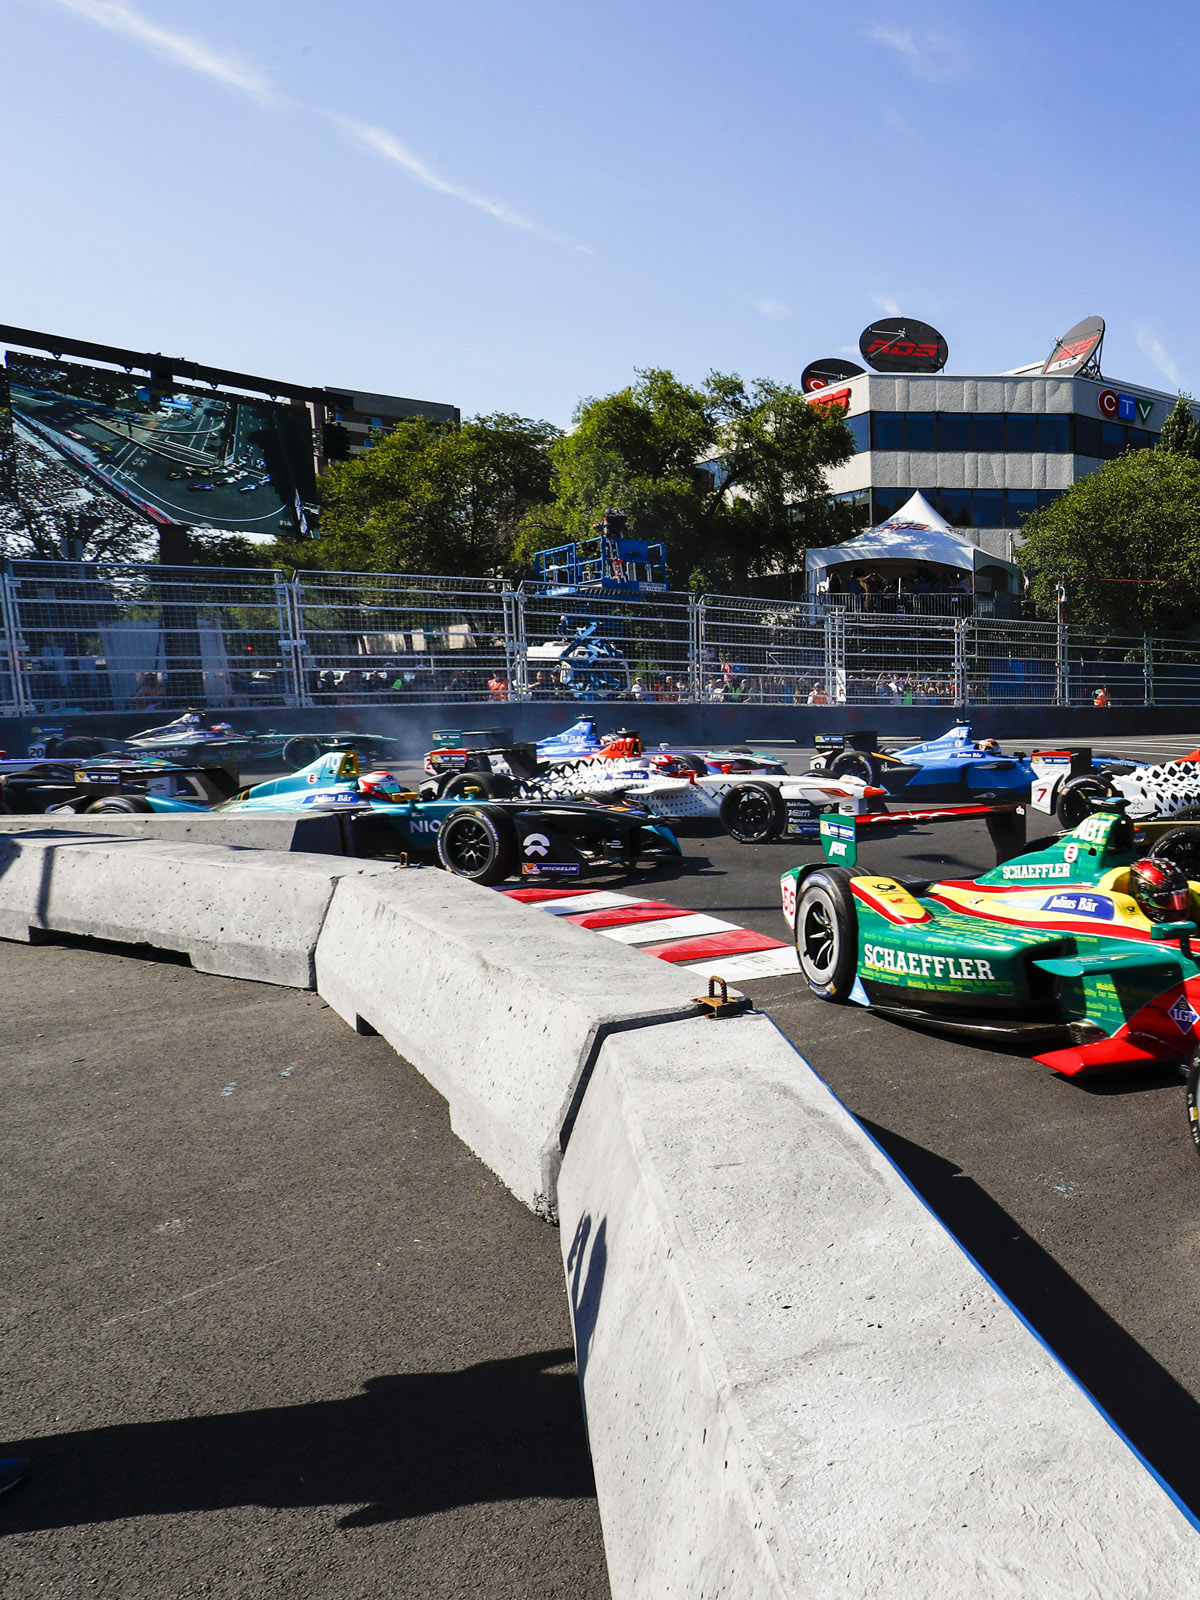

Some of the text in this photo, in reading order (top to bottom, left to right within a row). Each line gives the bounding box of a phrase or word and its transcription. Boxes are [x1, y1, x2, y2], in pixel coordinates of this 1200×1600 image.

[1103, 395, 1152, 419] CTV
[569, 736, 587, 744] DAC
[951, 729, 968, 738] BUE
[337, 793, 353, 803] Bär
[1038, 788, 1047, 802] 7
[1073, 818, 1112, 843] ABT
[829, 842, 848, 856] ABT
[1002, 863, 1070, 879] SCHAEFFLER
[783, 886, 797, 917] 66
[1047, 895, 1099, 912] Julius Bär
[864, 943, 995, 980] SCHAEFFLER
[1173, 1008, 1195, 1023] LGT
